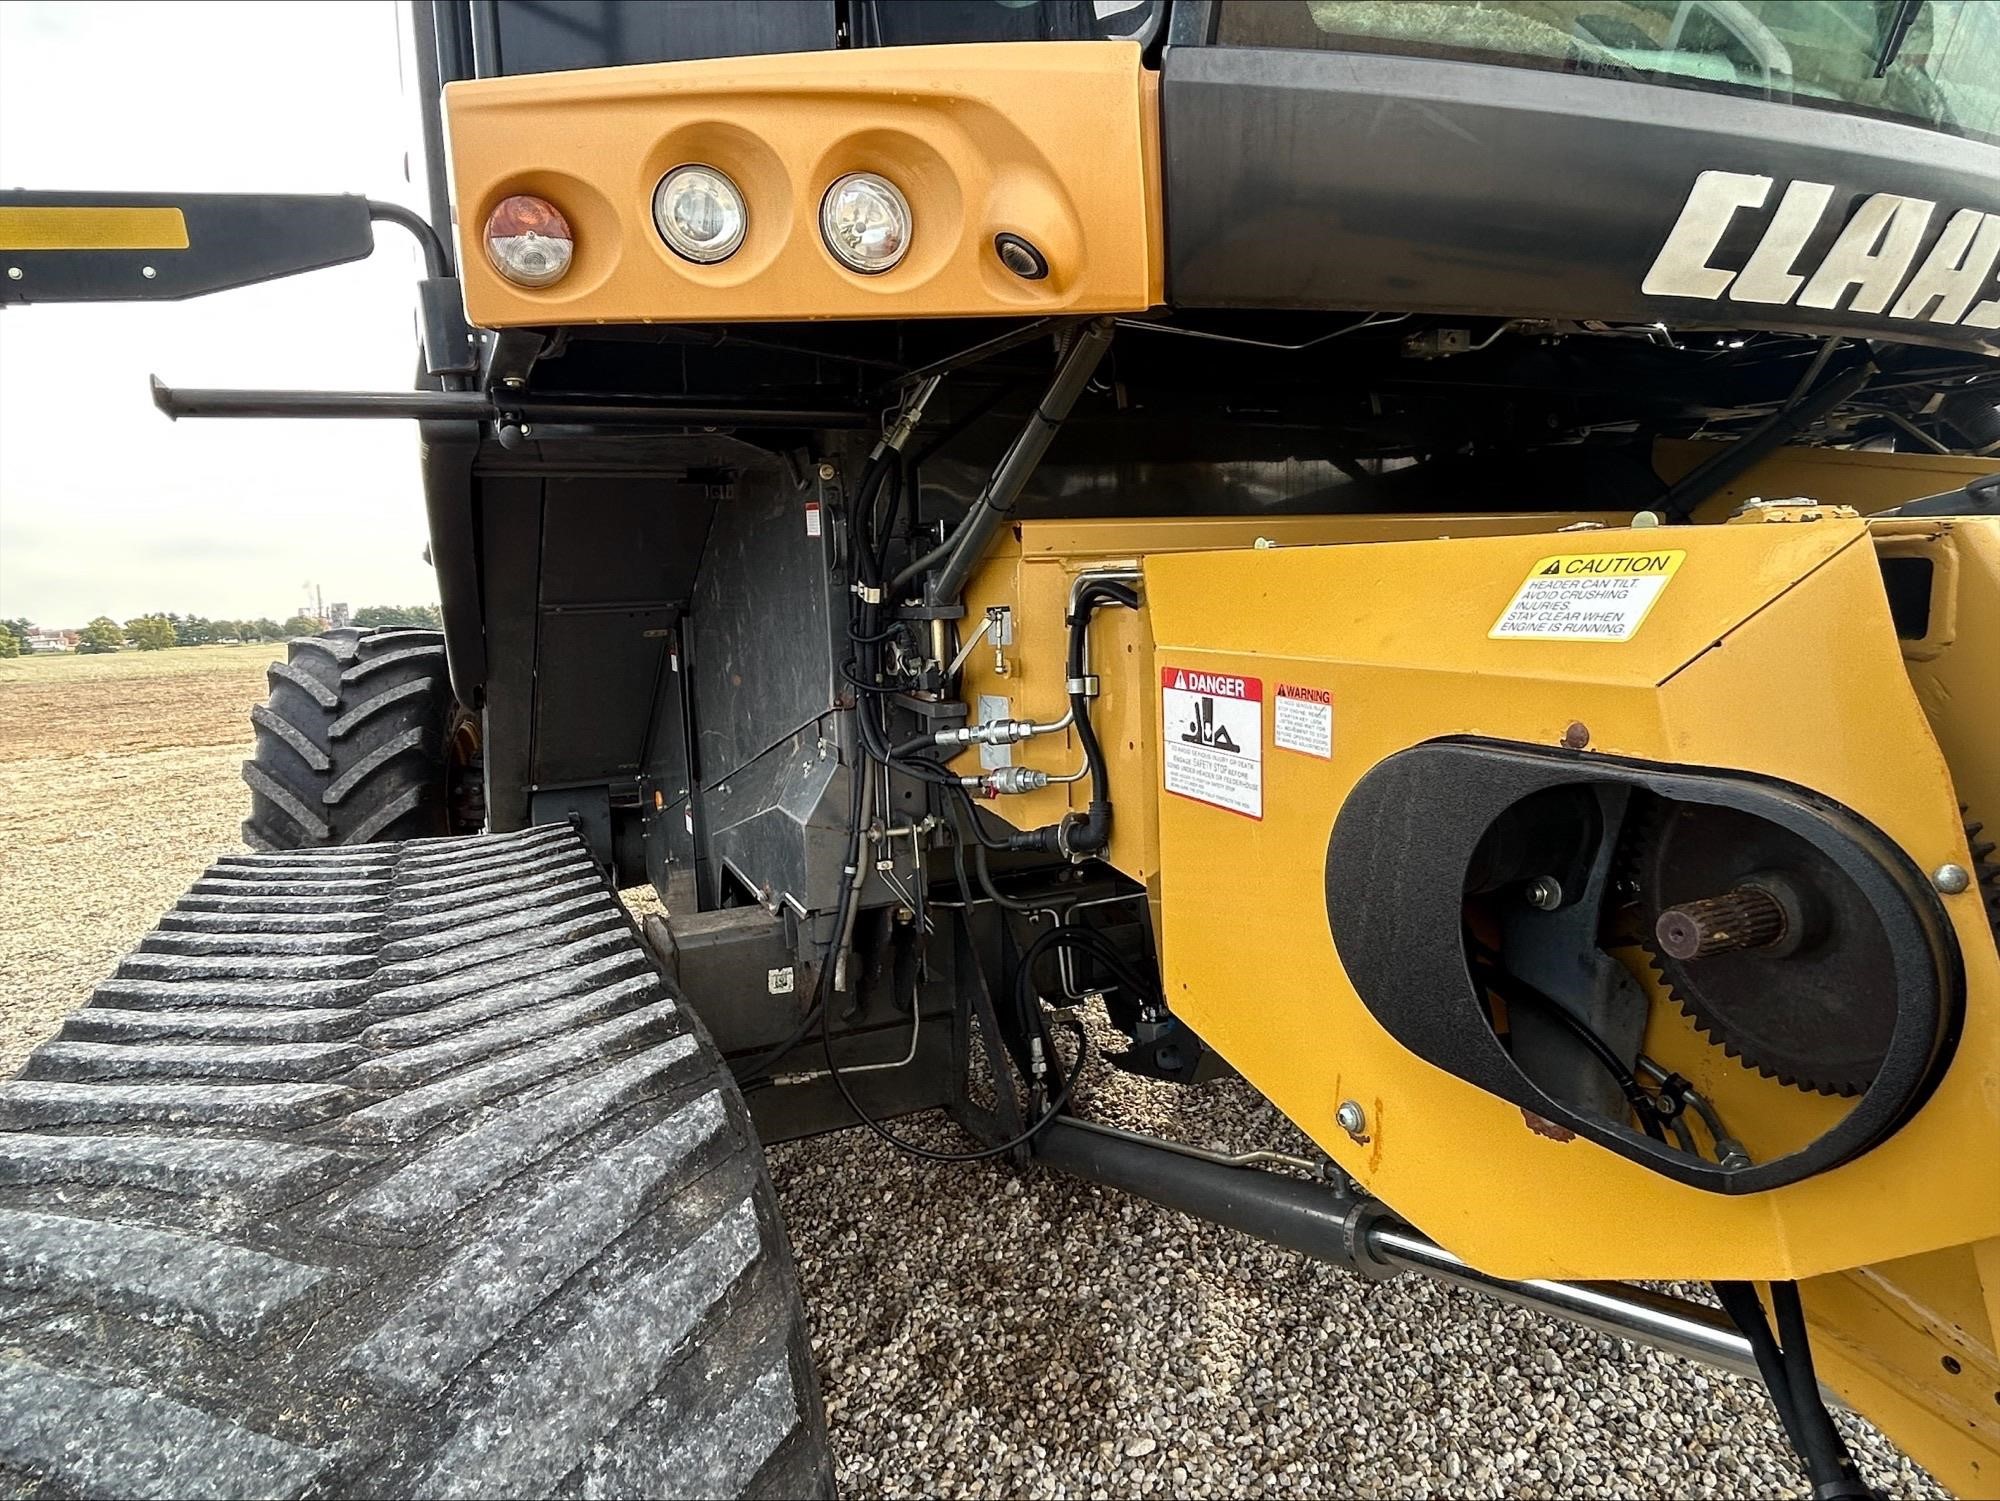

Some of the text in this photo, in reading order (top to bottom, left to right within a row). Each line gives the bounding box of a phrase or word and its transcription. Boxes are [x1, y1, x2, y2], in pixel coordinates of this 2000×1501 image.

[1565, 555, 1671, 574] CAUTION
[1529, 580, 1580, 590] HEADER
[1581, 579, 1609, 589] CAN
[1521, 589, 1629, 600] AVOID CRUSHING
[1507, 611, 1625, 622] STAY CLEAR WHEN
[1500, 622, 1626, 634] ENGINE IS RUNNING.
[1188, 673, 1246, 698] DANGER
[1286, 684, 1330, 704] WARNING
